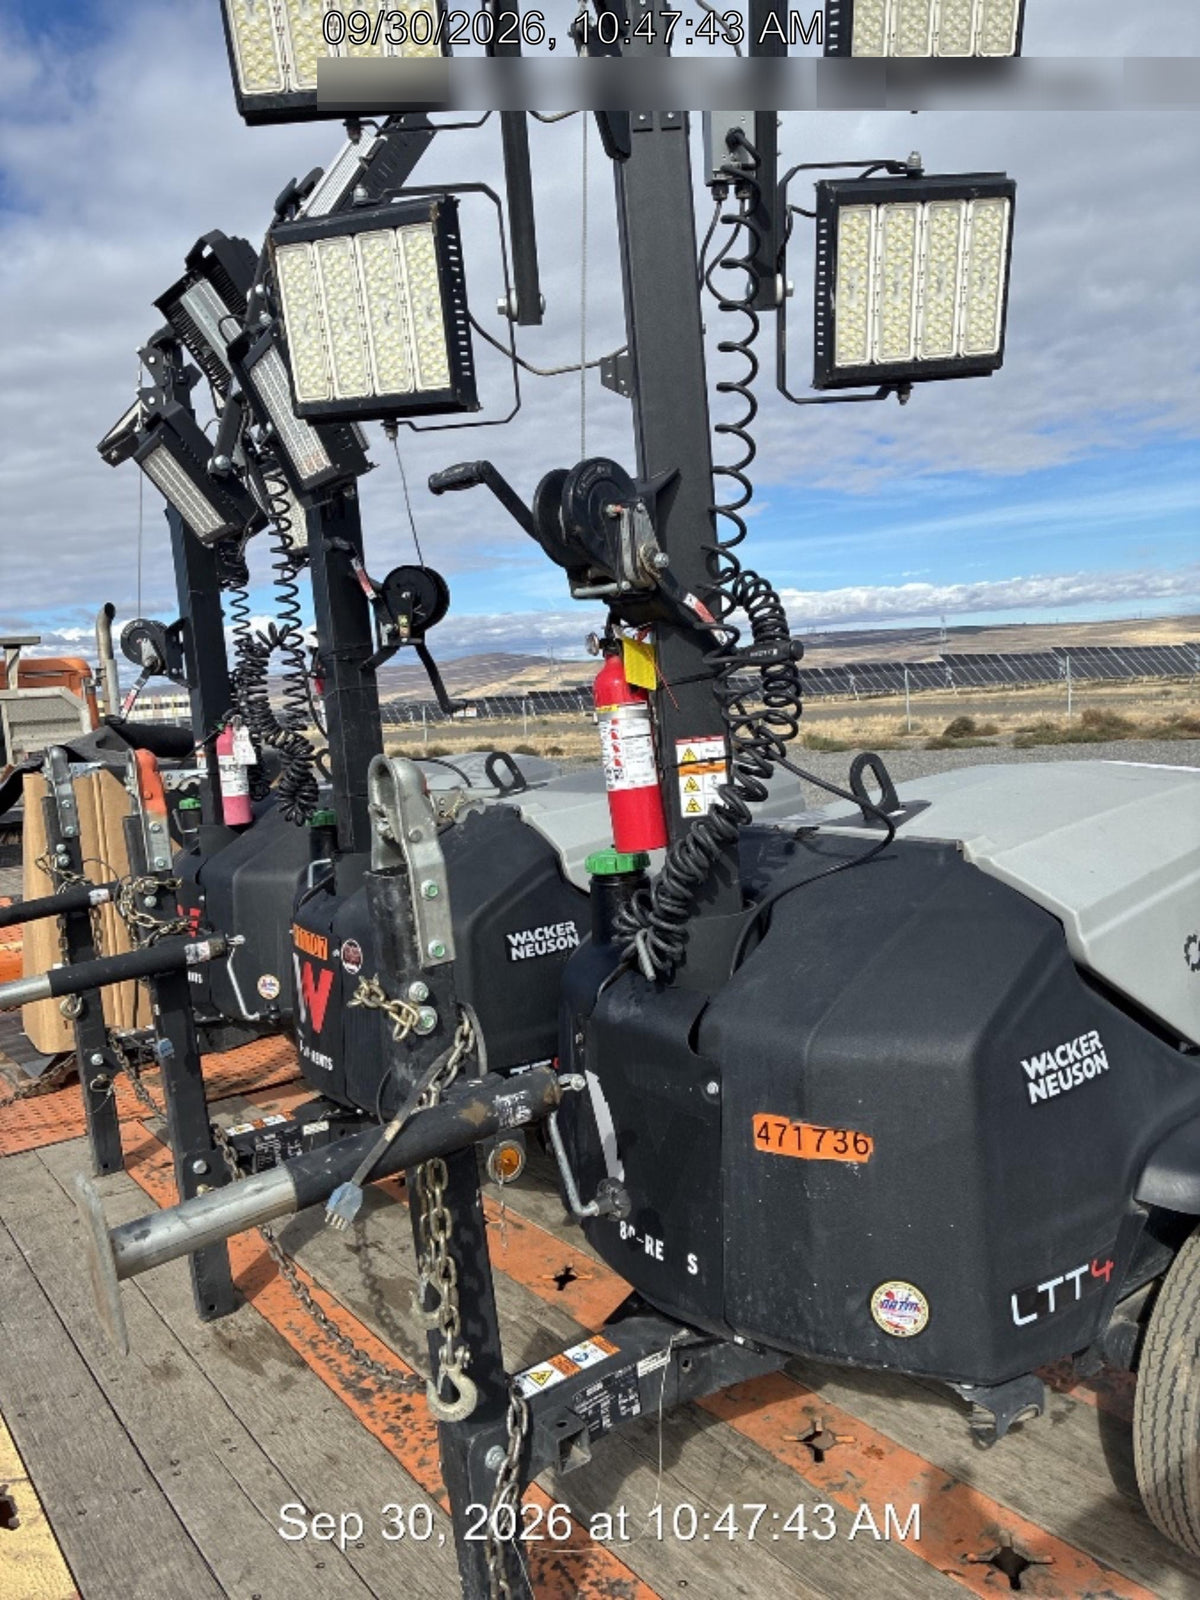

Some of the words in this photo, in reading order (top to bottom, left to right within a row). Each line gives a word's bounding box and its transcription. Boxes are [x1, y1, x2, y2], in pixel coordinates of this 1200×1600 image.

[506, 920, 577, 947] WACKER
[511, 932, 580, 961] NEUSON
[1020, 1029, 1104, 1080] WACKER
[1028, 1049, 1110, 1105] NEUSON
[757, 1121, 869, 1155] 471736
[1011, 1258, 1115, 1326] LTT4
